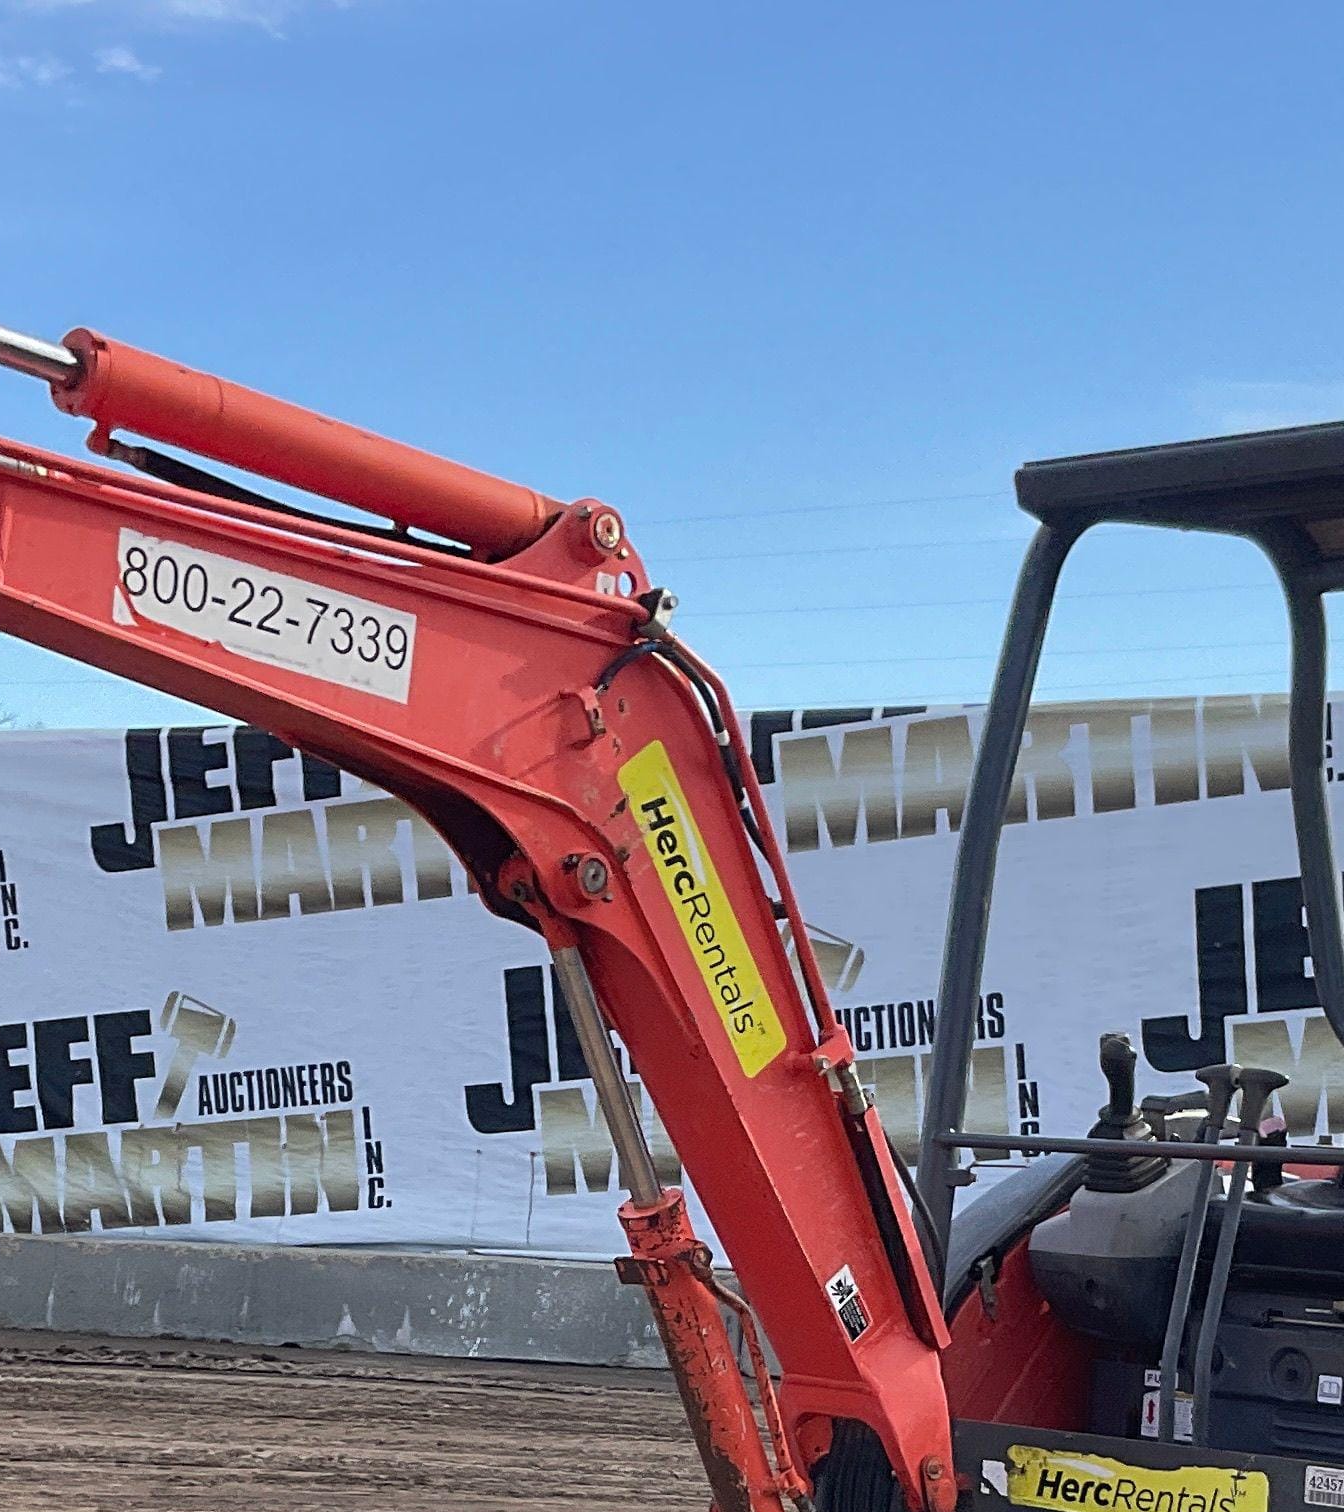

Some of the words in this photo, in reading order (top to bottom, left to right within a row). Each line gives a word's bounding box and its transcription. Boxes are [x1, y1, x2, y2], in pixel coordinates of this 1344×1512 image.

[122, 546, 408, 671] 800-22-7339
[159, 797, 480, 932] MART
[197, 1060, 354, 1117] AUCTIONEERS
